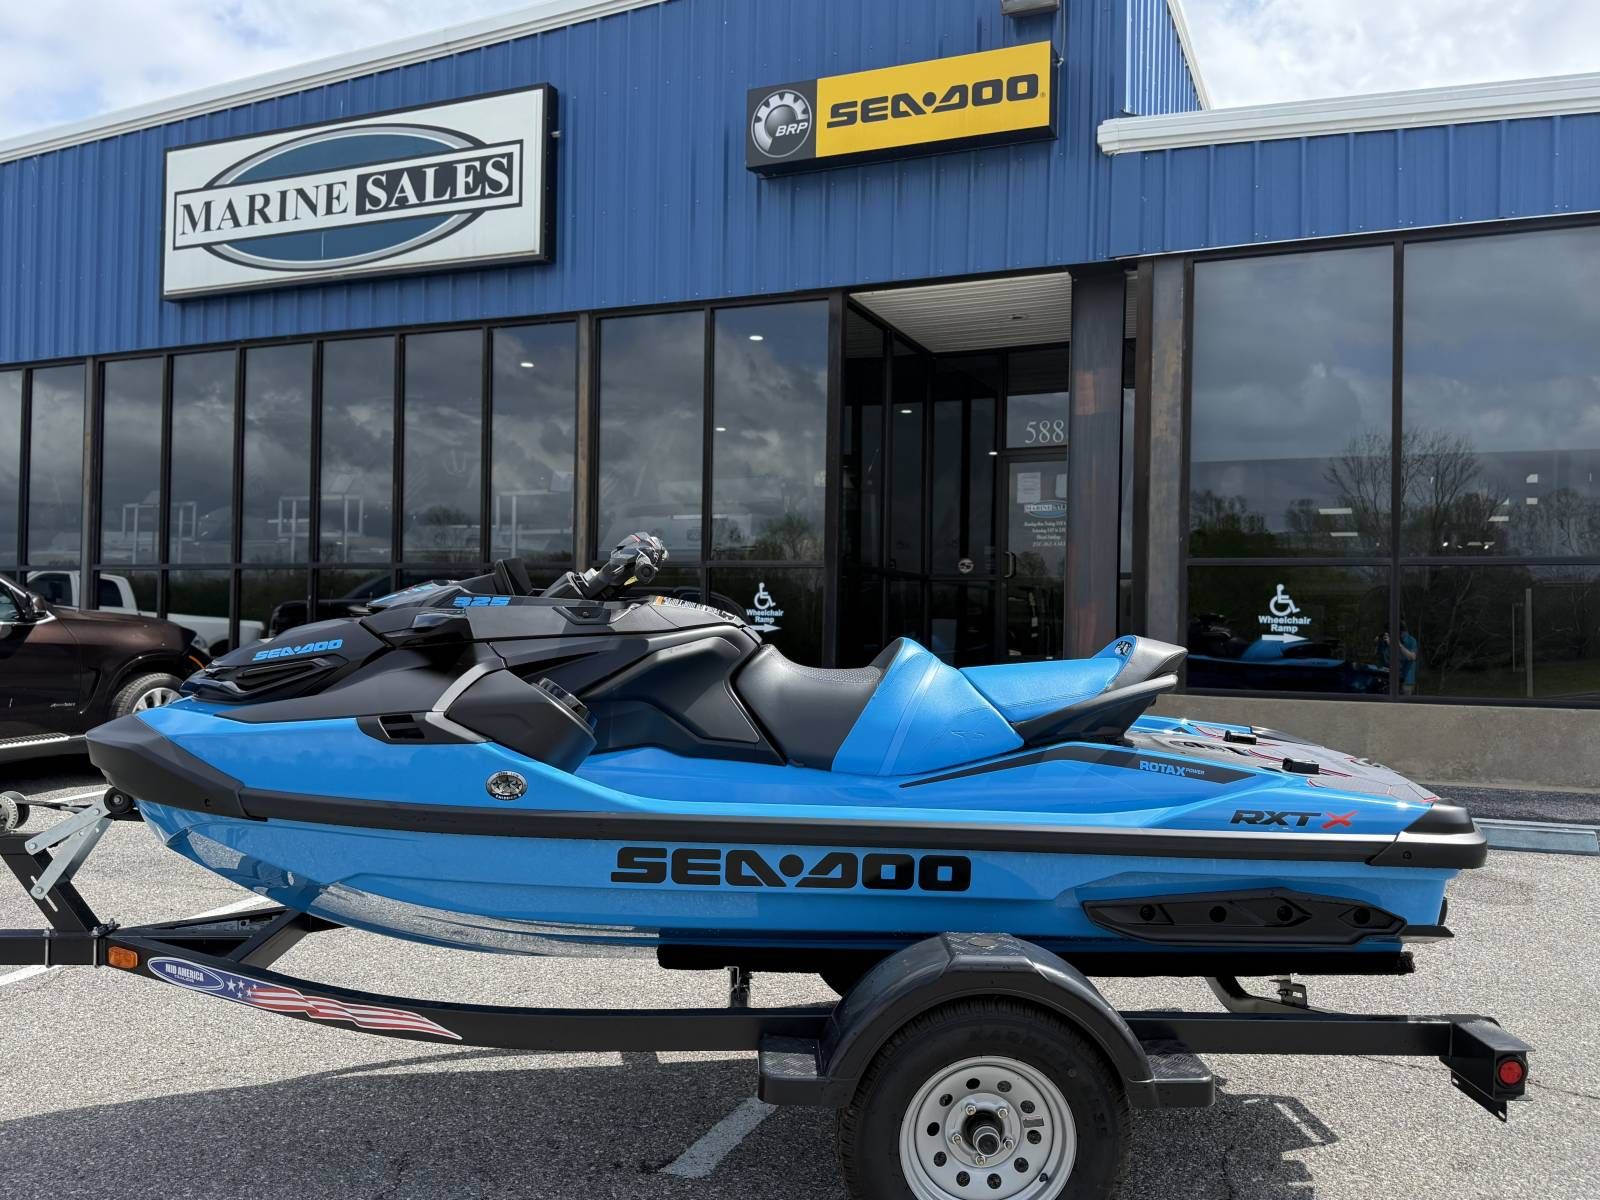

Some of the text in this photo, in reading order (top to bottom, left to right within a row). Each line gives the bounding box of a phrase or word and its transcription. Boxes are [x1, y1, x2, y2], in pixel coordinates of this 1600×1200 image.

[774, 121, 809, 137] BRP
[178, 155, 511, 236] MARINE SALES
[1024, 420, 1064, 444] 588
[746, 608, 784, 618] Wheelchair
[755, 616, 774, 624] Ramp
[1258, 616, 1311, 624] Wheelchair
[1271, 624, 1298, 632] Ramp
[1139, 761, 1185, 777] ROTAX
[1230, 809, 1321, 825] RXT
[166, 964, 204, 981] MID AMERICA
